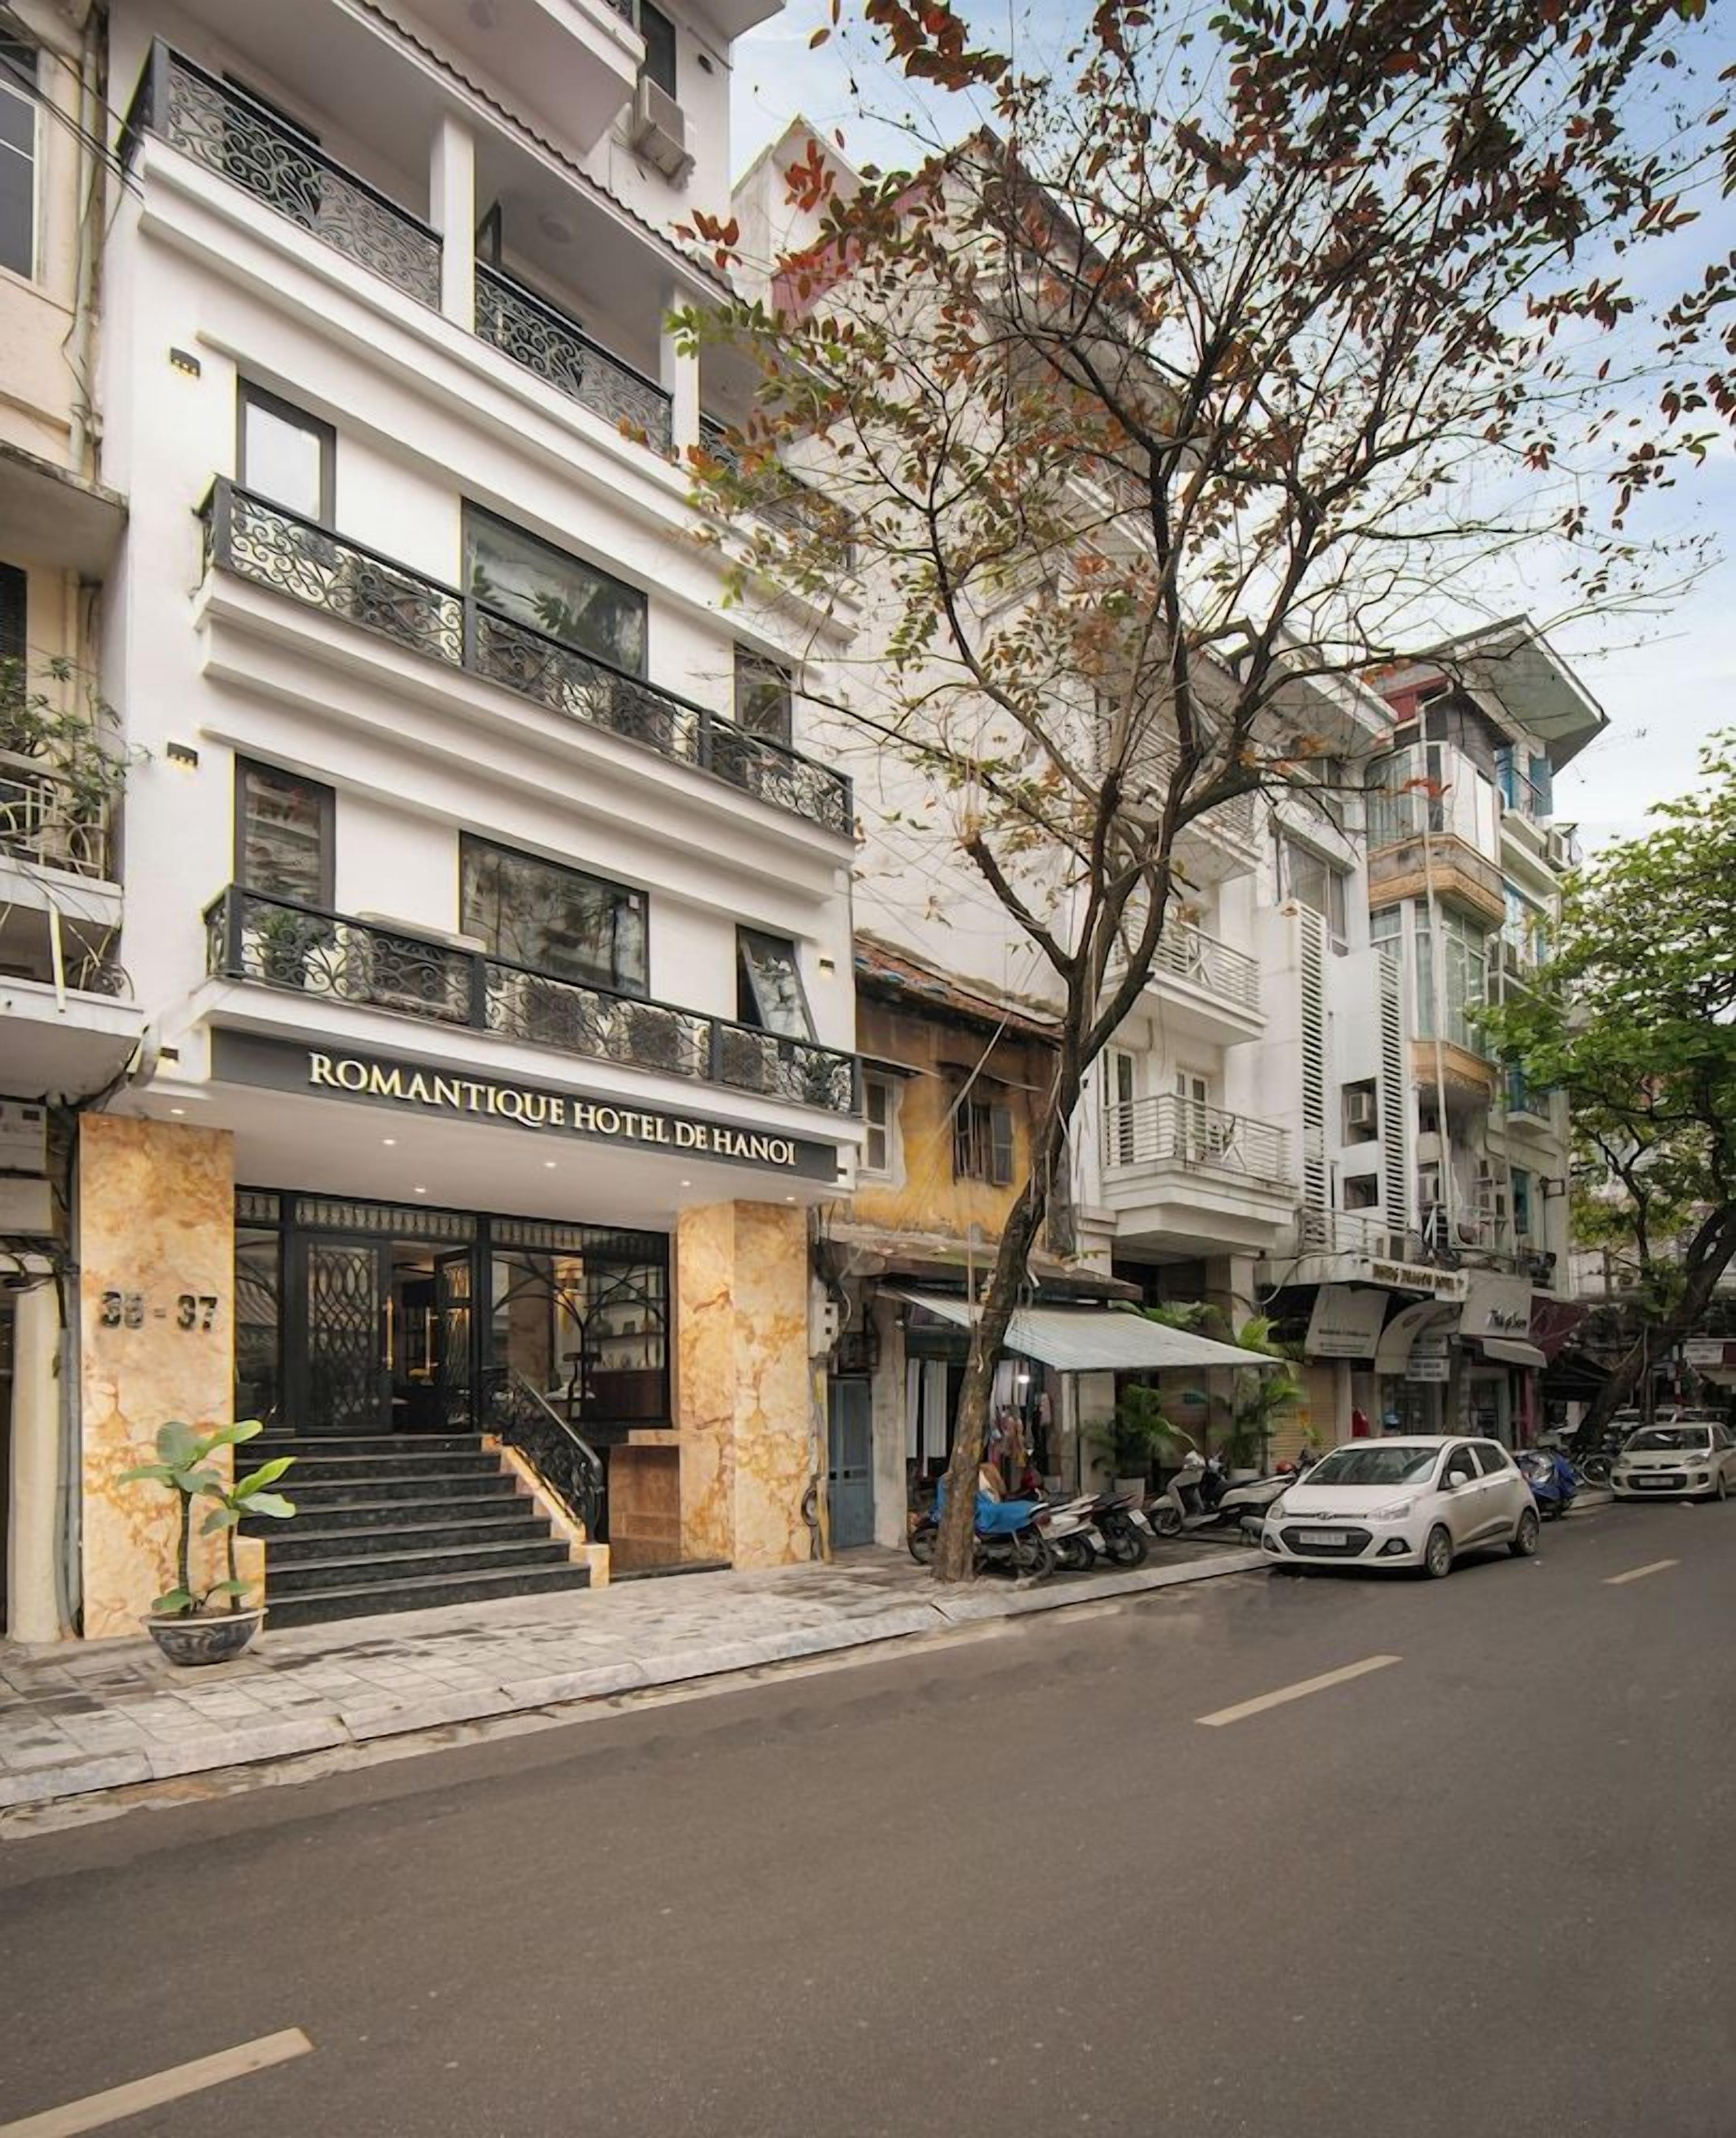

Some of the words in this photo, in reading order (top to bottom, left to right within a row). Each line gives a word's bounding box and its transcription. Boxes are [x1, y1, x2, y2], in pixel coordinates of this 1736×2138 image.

[309, 1052, 565, 1127] ROMANTIQUE
[574, 1102, 670, 1143] HOTEL
[674, 1120, 708, 1150] DE
[712, 1128, 796, 1166] HANOI
[177, 1294, 218, 1331] 37
